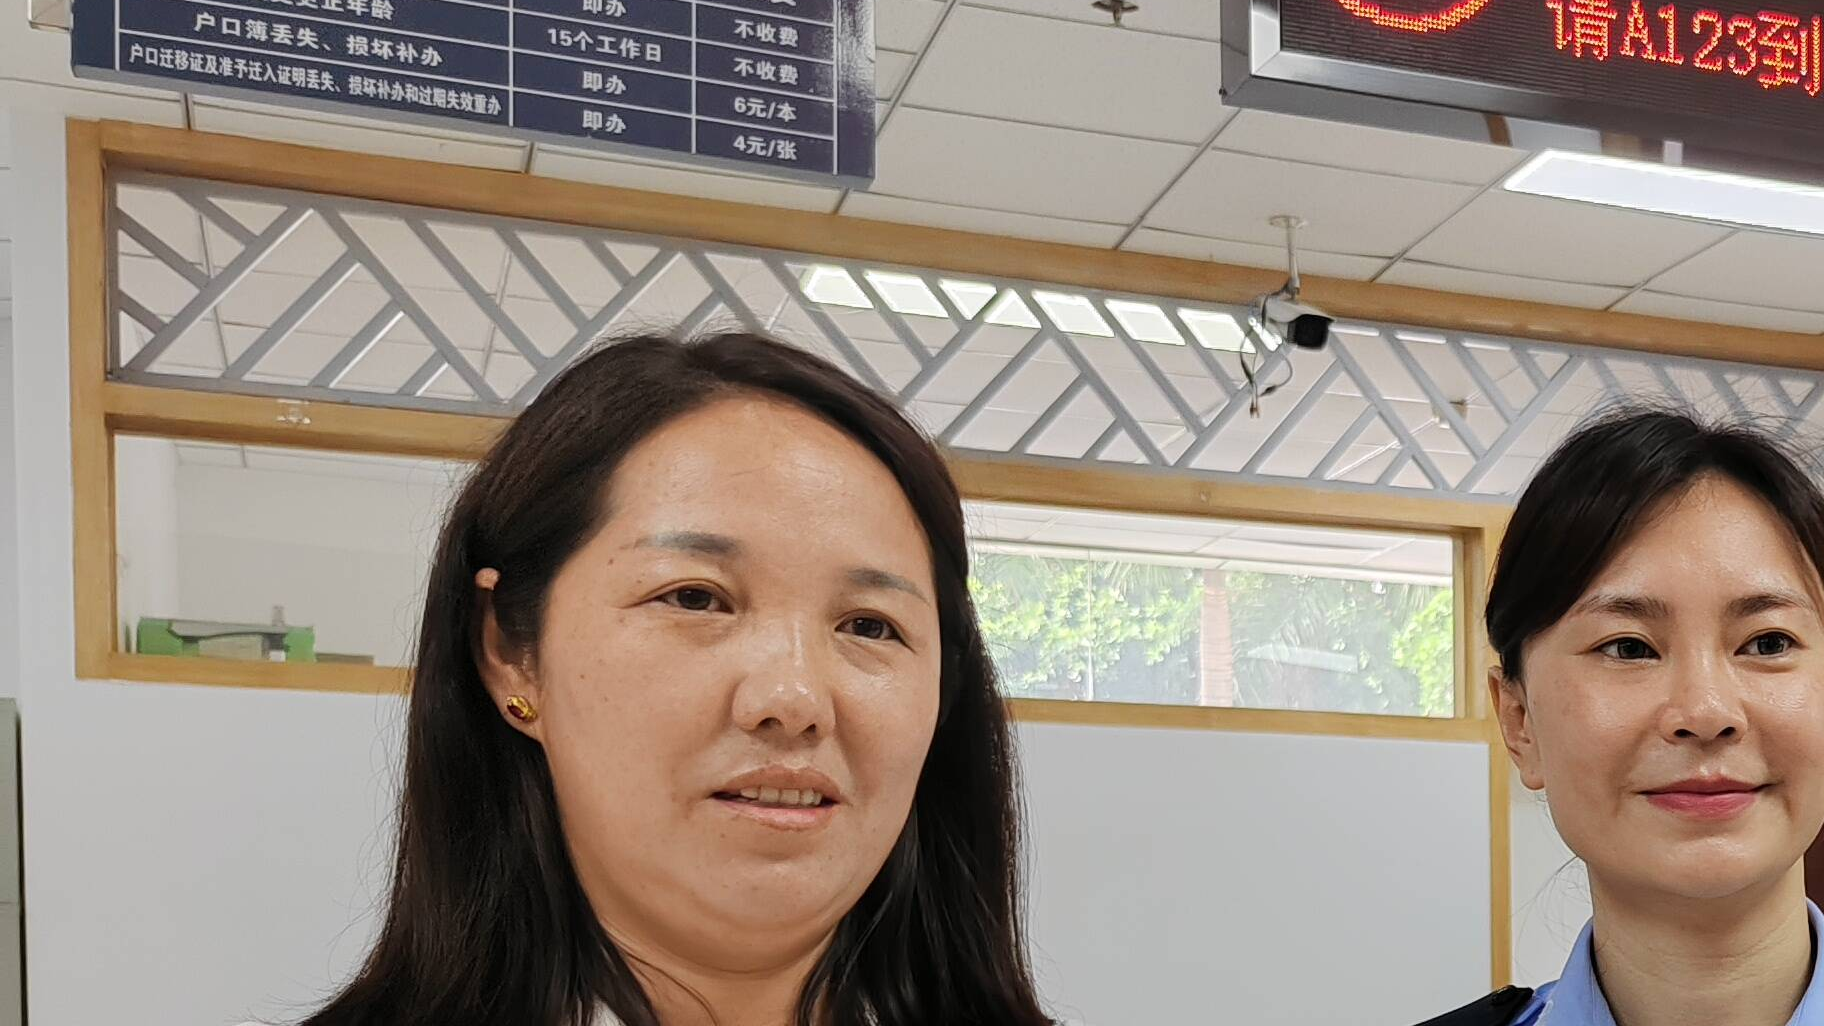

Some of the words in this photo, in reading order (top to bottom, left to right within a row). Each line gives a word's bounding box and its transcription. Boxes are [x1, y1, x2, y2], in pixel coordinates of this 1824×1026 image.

[194, 12, 443, 68] 户口簿丢失、损坏补办
[548, 28, 662, 63] 15个工作日
[734, 19, 799, 48] 不收费
[582, 71, 627, 96] 即办
[734, 57, 799, 86] 不收费
[582, 110, 627, 135] 即办
[734, 97, 798, 124] 6元/本
[733, 135, 798, 161] 4元/张
